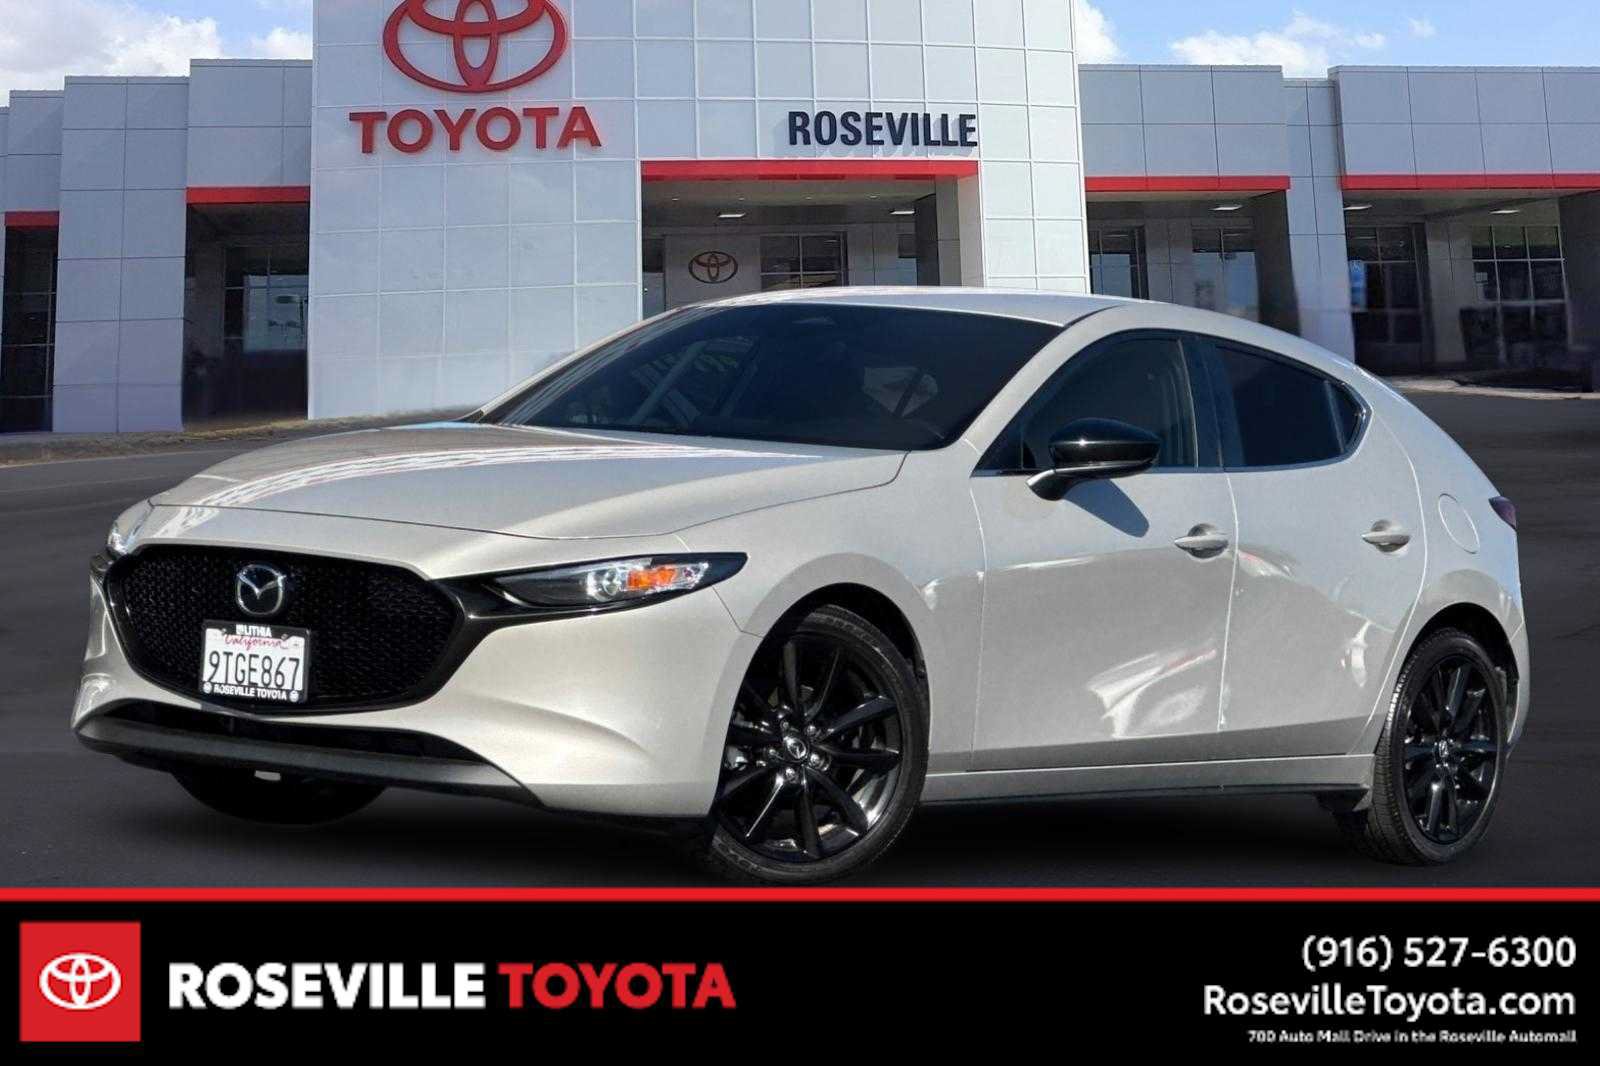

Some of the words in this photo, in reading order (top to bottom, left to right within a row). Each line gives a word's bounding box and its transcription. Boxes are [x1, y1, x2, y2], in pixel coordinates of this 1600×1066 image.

[349, 106, 602, 154] TOYOTA
[788, 111, 978, 147] ROSEVILLE
[207, 650, 300, 689] 9TGE867
[213, 684, 256, 697] ROSEVILLE
[257, 688, 287, 700] TOYOTA
